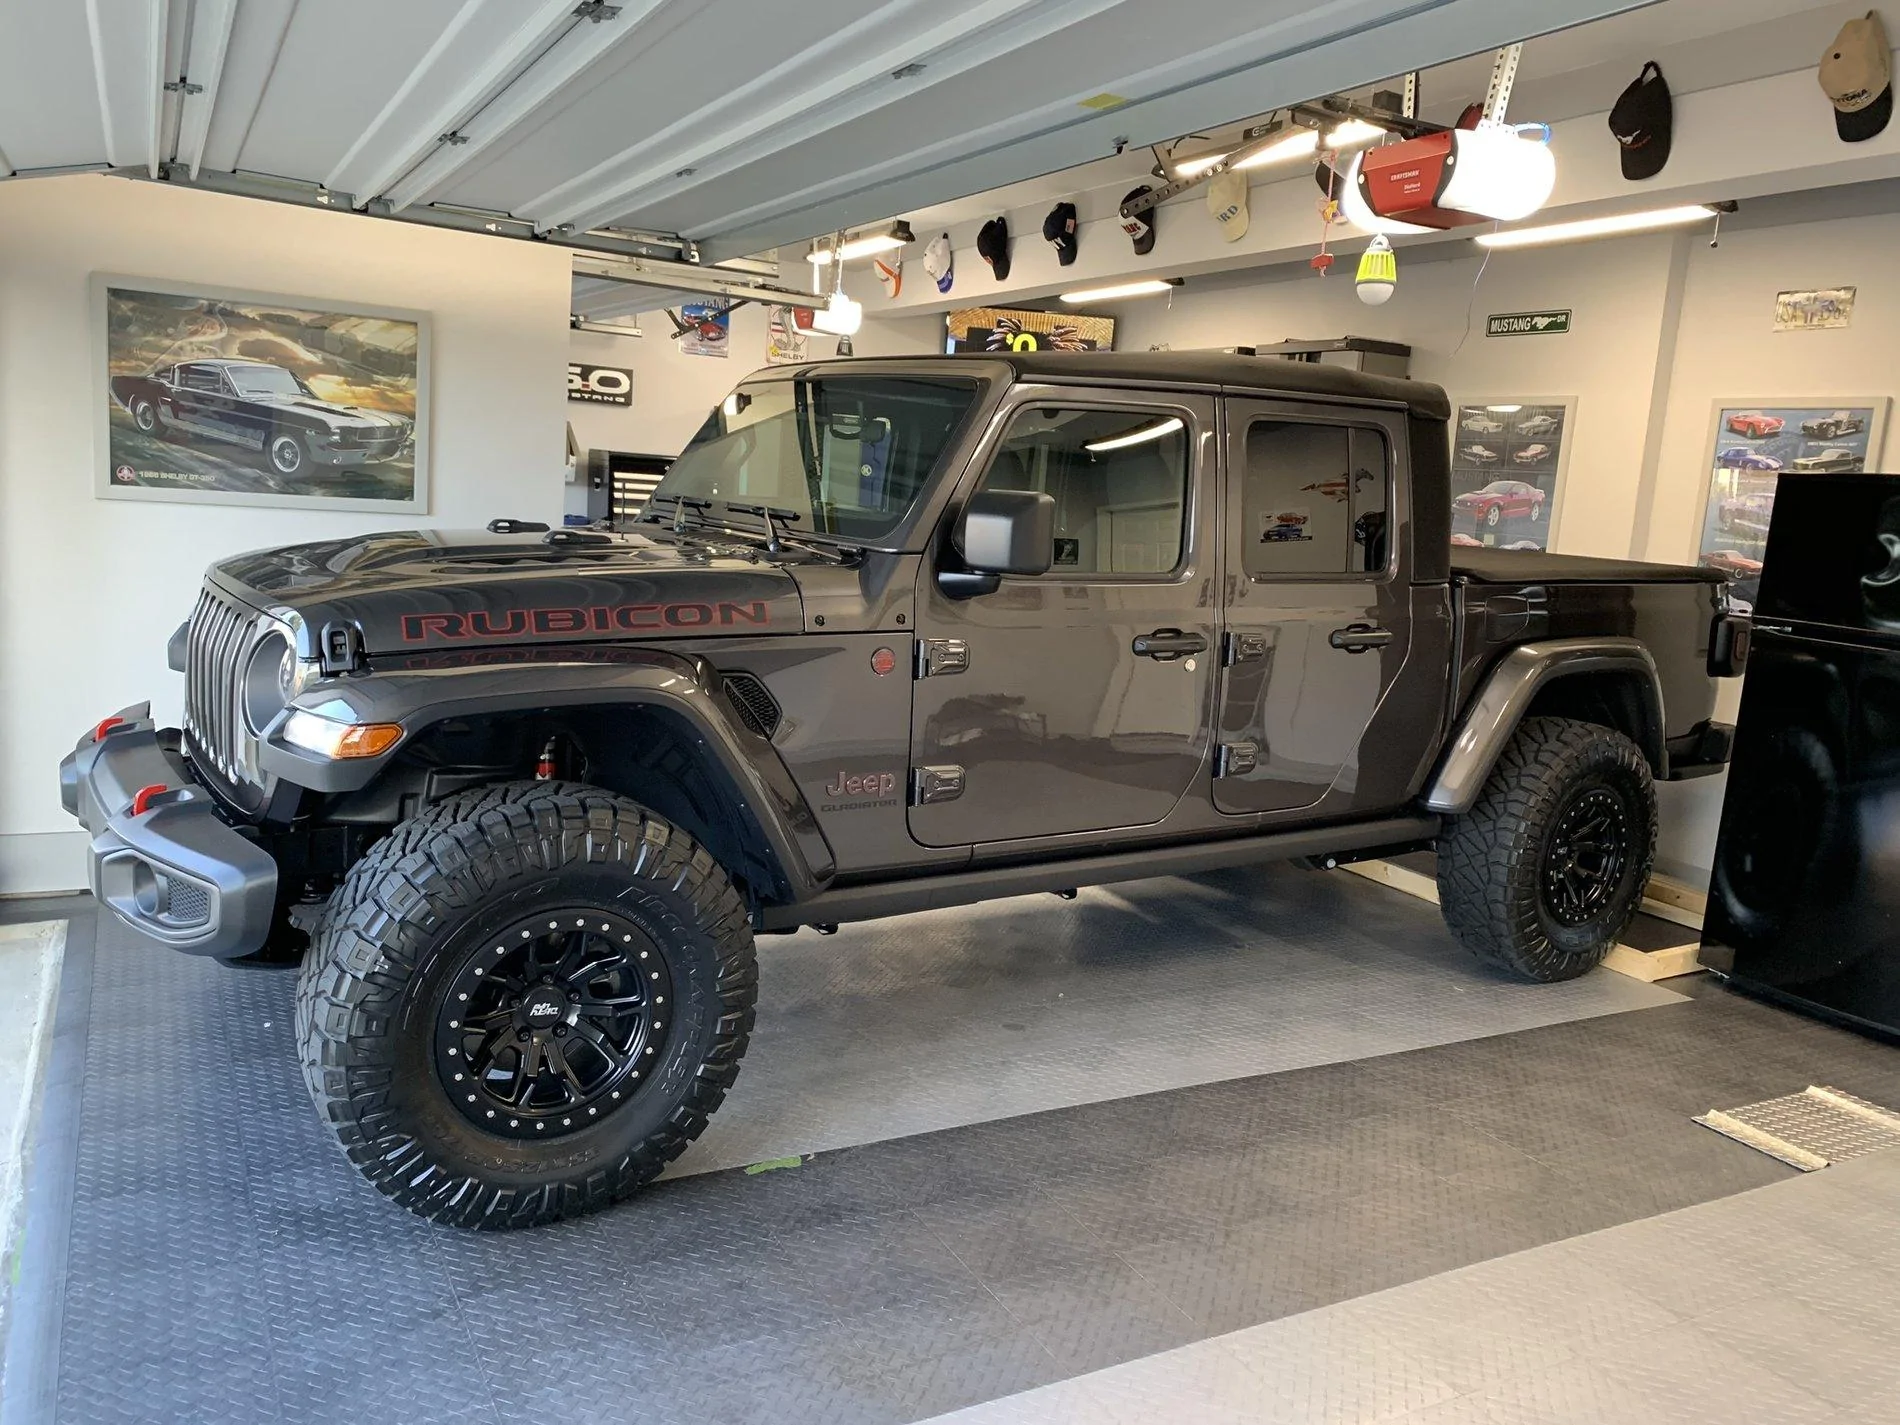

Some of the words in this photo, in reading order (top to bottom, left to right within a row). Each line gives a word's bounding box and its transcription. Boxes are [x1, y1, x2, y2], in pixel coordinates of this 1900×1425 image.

[1390, 170, 1420, 181] CRAFTSMAN
[1490, 317, 1531, 333] MUSTANG
[1556, 314, 1567, 323] DR
[771, 351, 805, 361] SHELBY
[571, 392, 625, 403] STANG
[402, 602, 771, 643] RUBICON
[825, 771, 896, 798] Jeep
[821, 799, 897, 813] GLADIATOR
